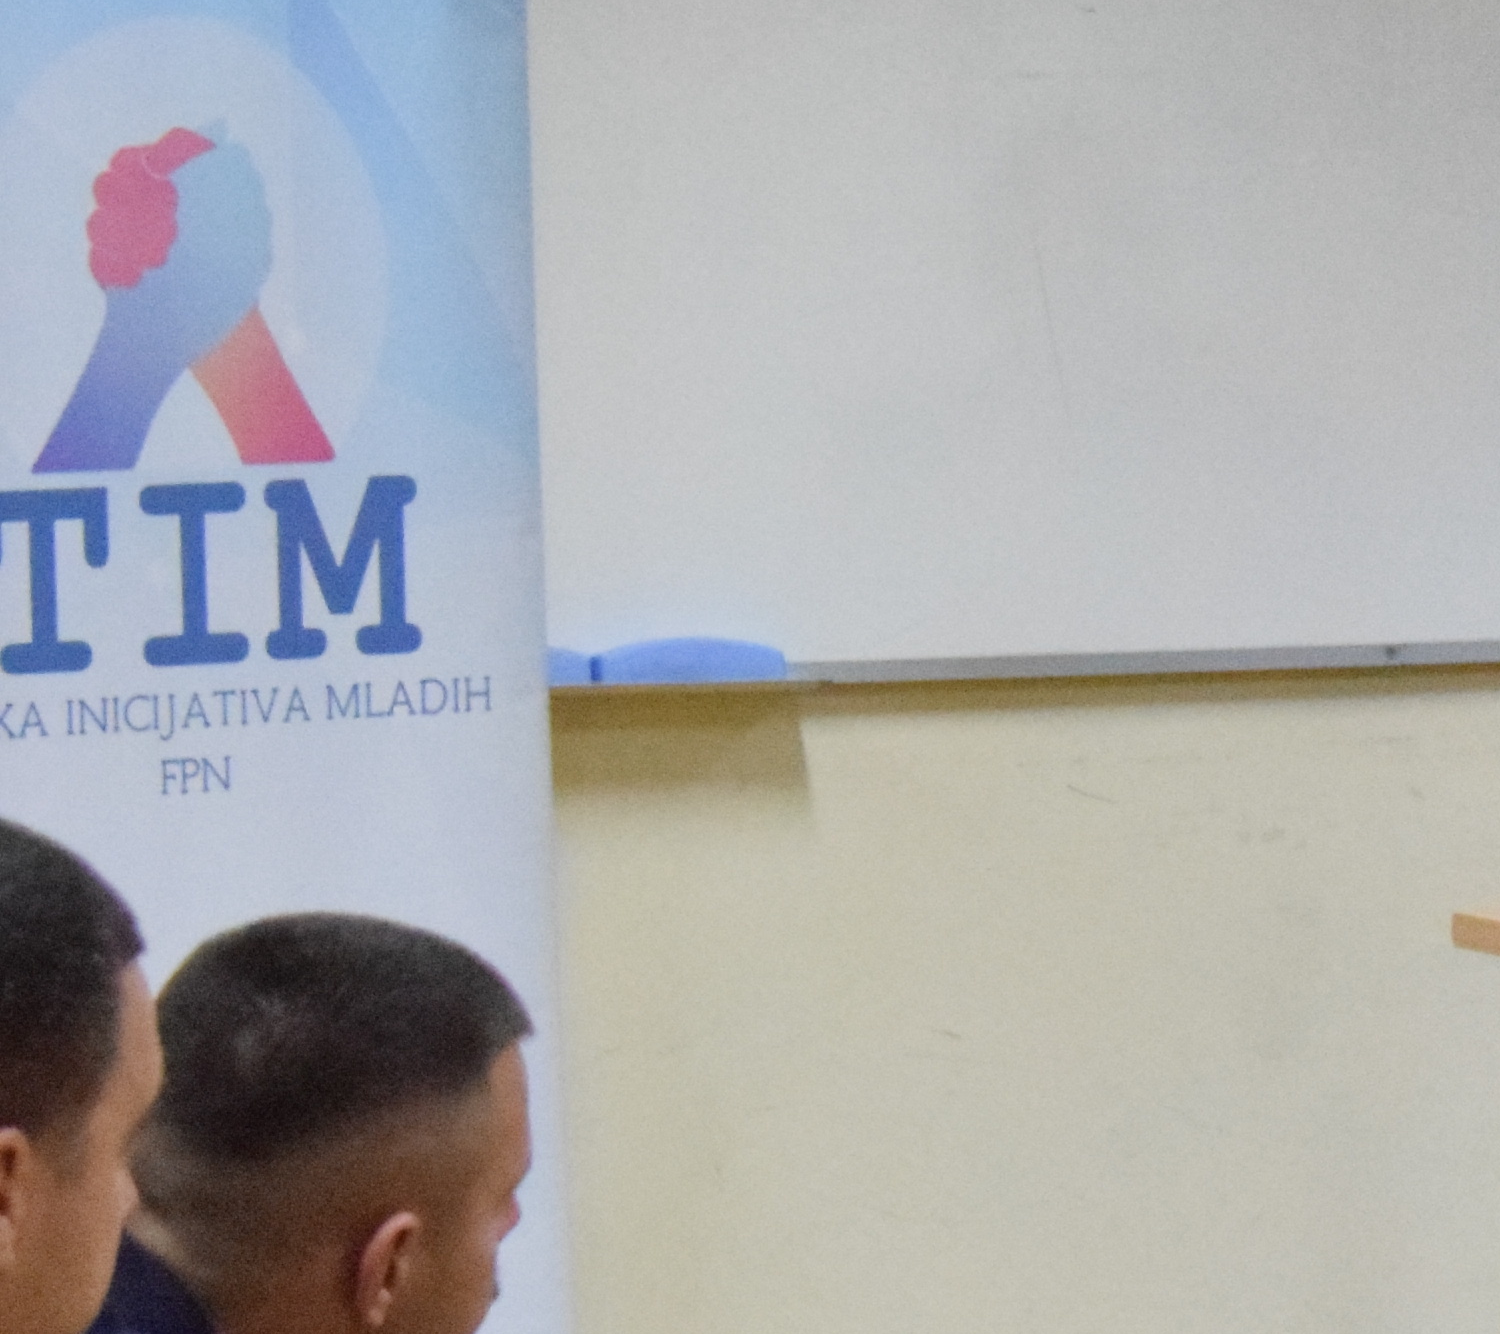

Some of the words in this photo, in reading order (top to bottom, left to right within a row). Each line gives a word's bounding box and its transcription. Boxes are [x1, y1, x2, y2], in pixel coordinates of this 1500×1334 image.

[66, 685, 311, 741] INICIJATIVA
[326, 675, 493, 722] MLADIH
[160, 755, 232, 795] FPN
